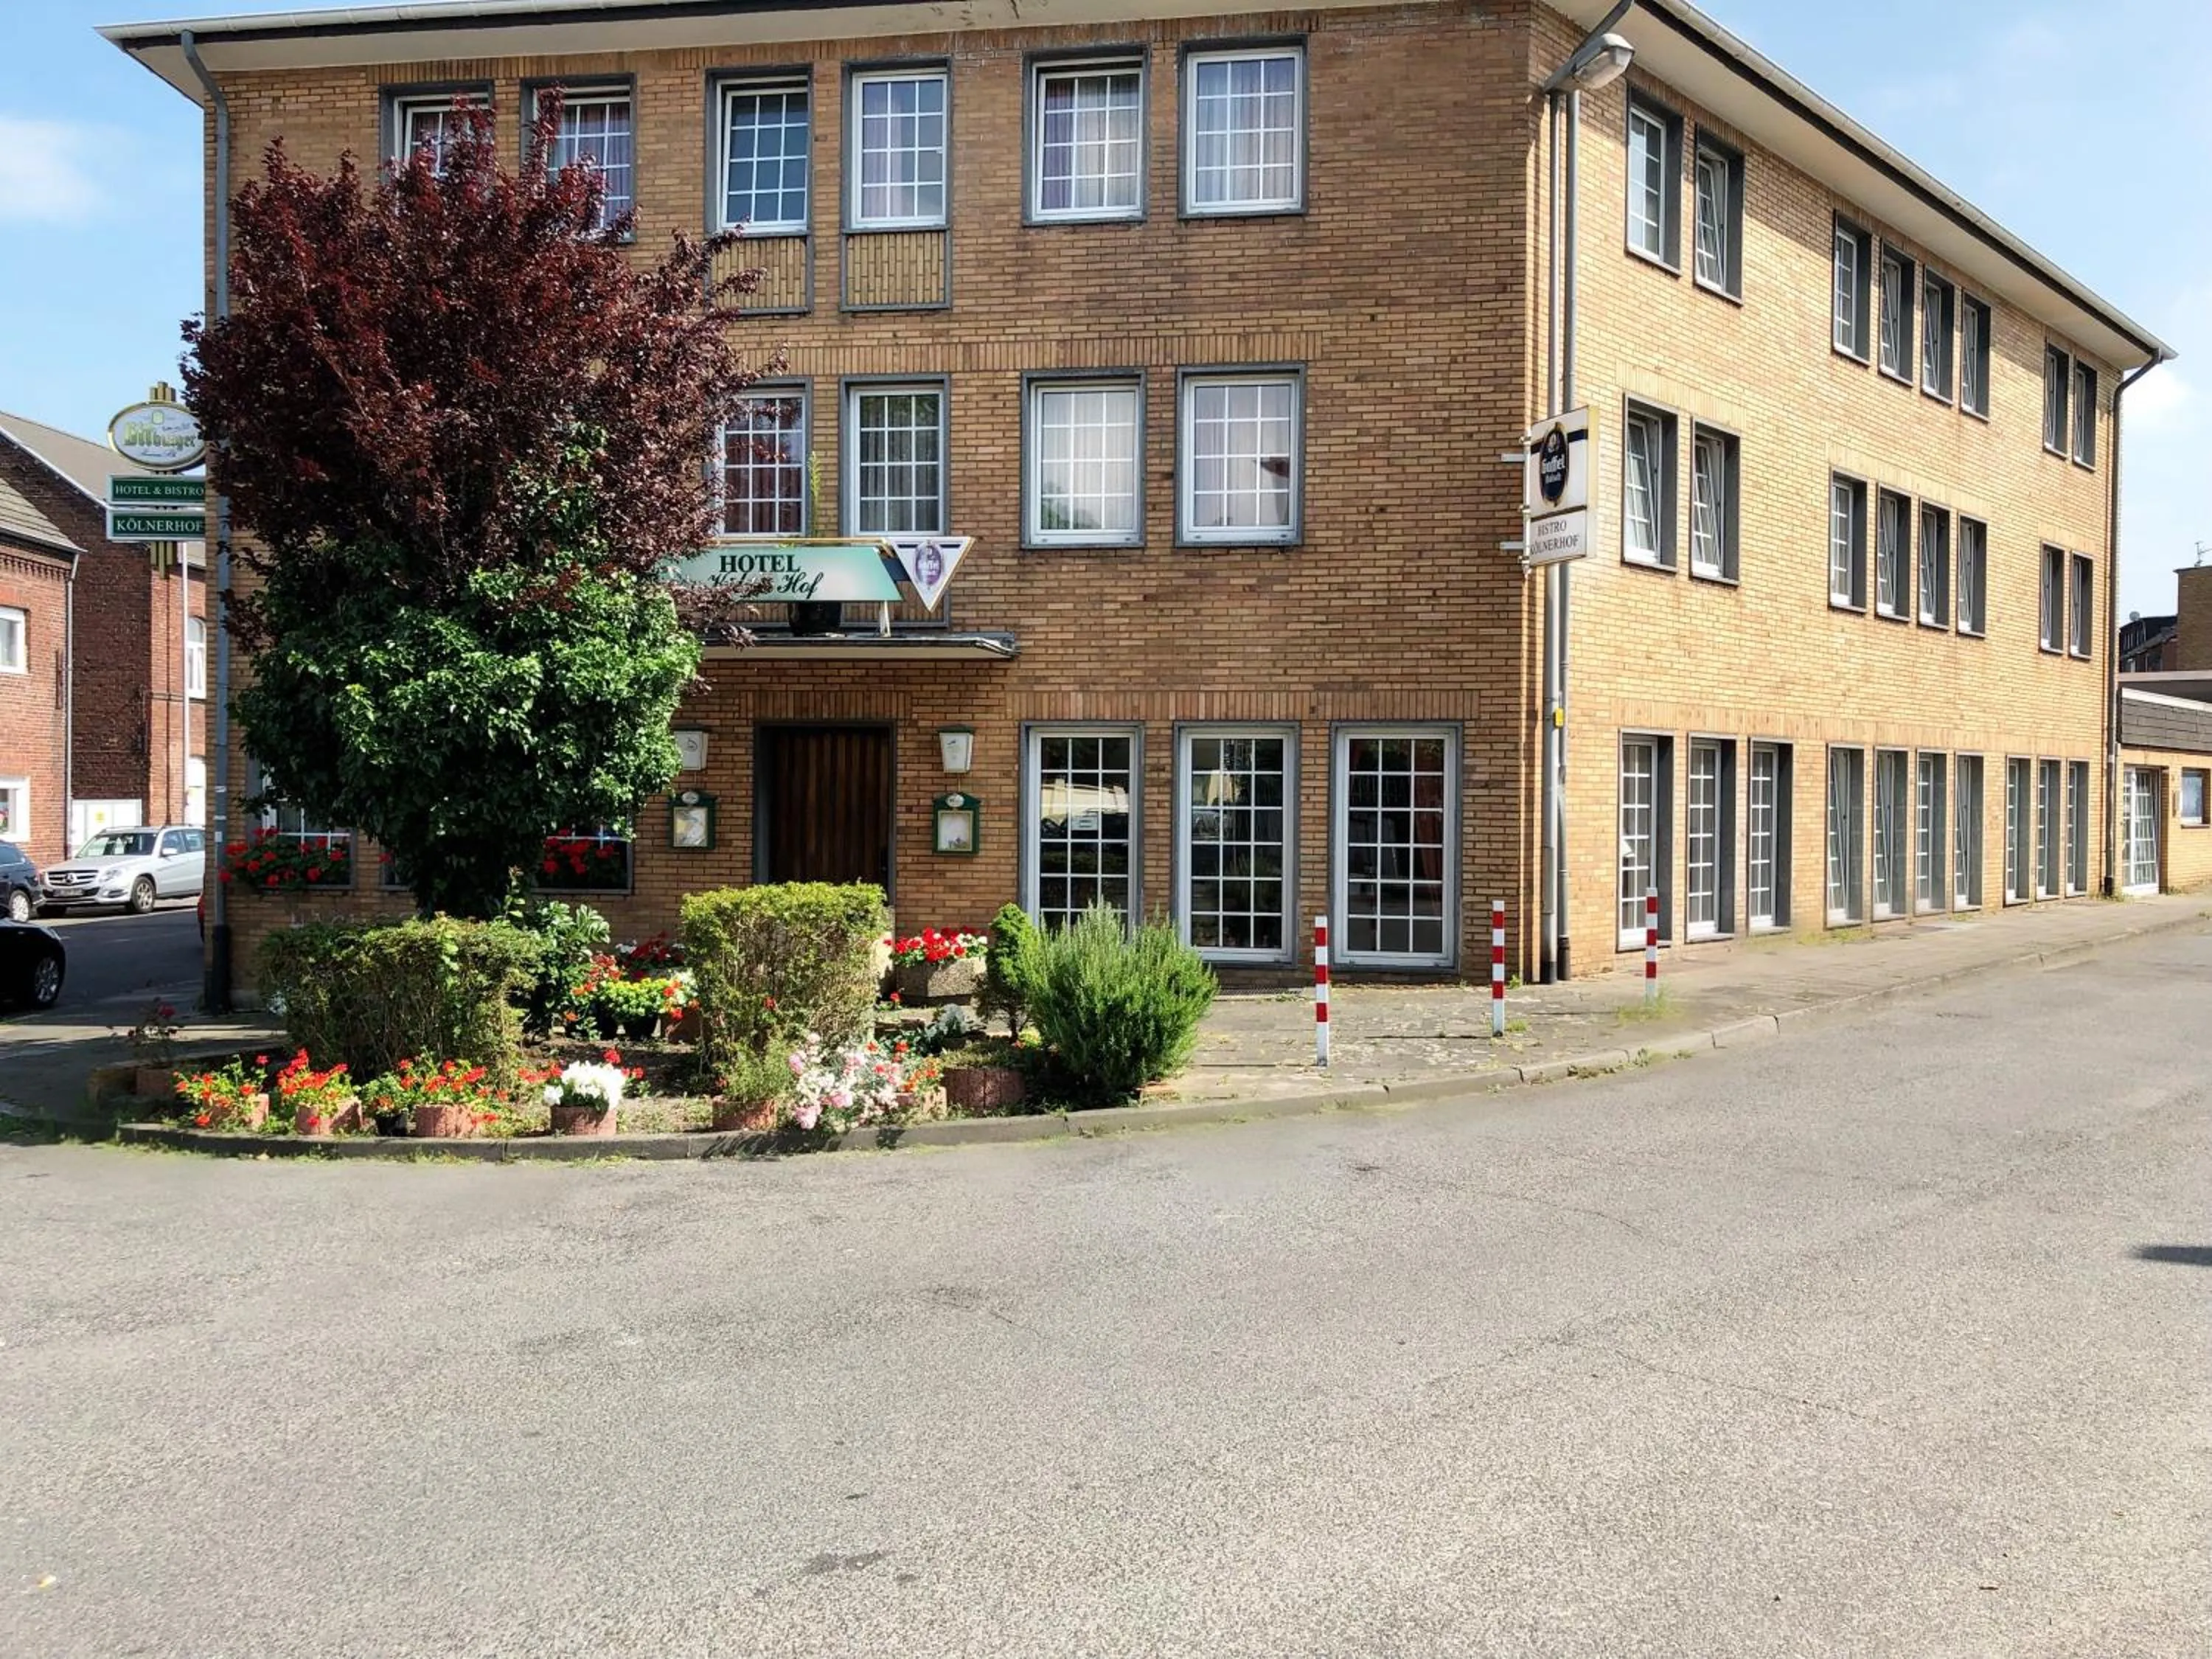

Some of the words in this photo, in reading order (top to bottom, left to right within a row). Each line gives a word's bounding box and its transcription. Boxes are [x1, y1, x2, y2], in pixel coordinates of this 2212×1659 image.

[115, 484, 151, 495] HOTEL
[153, 485, 162, 495] &
[165, 484, 204, 495] BISTRO
[1530, 533, 1580, 555] ÖLNERHOF
[719, 554, 801, 572] HOTEL
[777, 571, 824, 599] Hof
